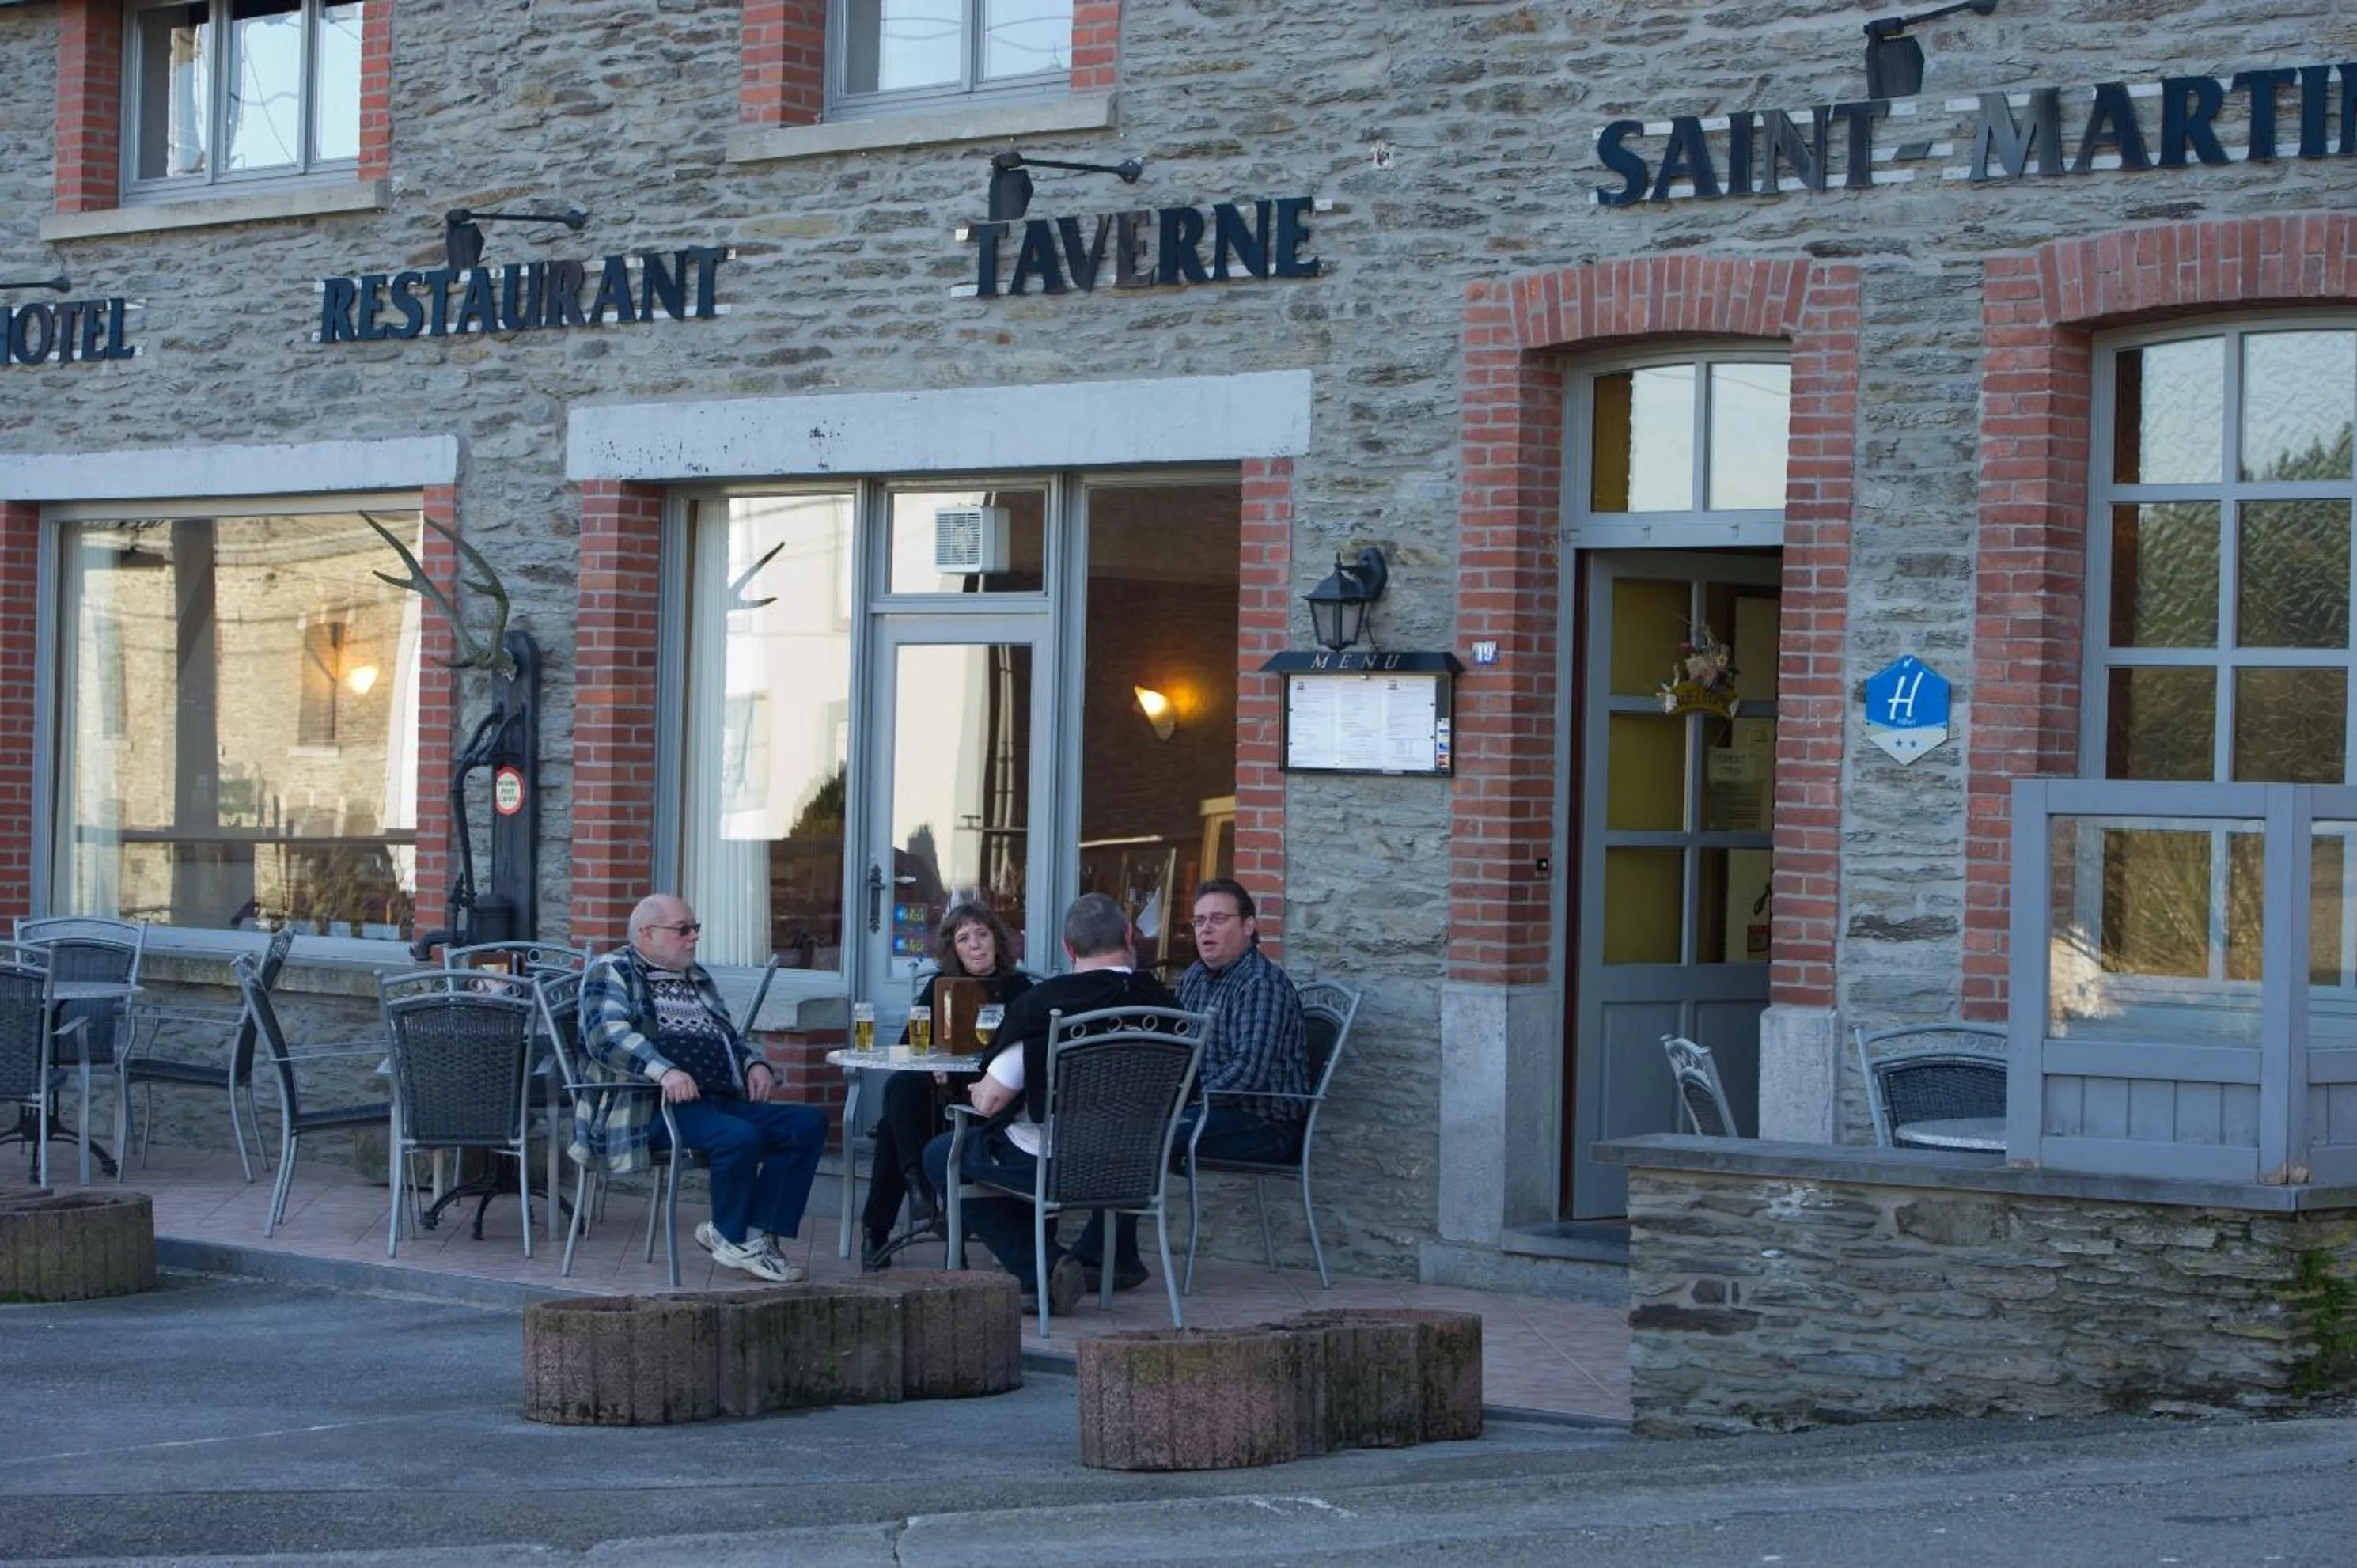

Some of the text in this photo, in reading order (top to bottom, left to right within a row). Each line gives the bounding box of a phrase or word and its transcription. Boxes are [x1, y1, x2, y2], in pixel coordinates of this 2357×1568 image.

[318, 247, 728, 343] RESTAURANT
[968, 195, 1319, 297] TAVERNE
[1310, 653, 1400, 669] MENU
